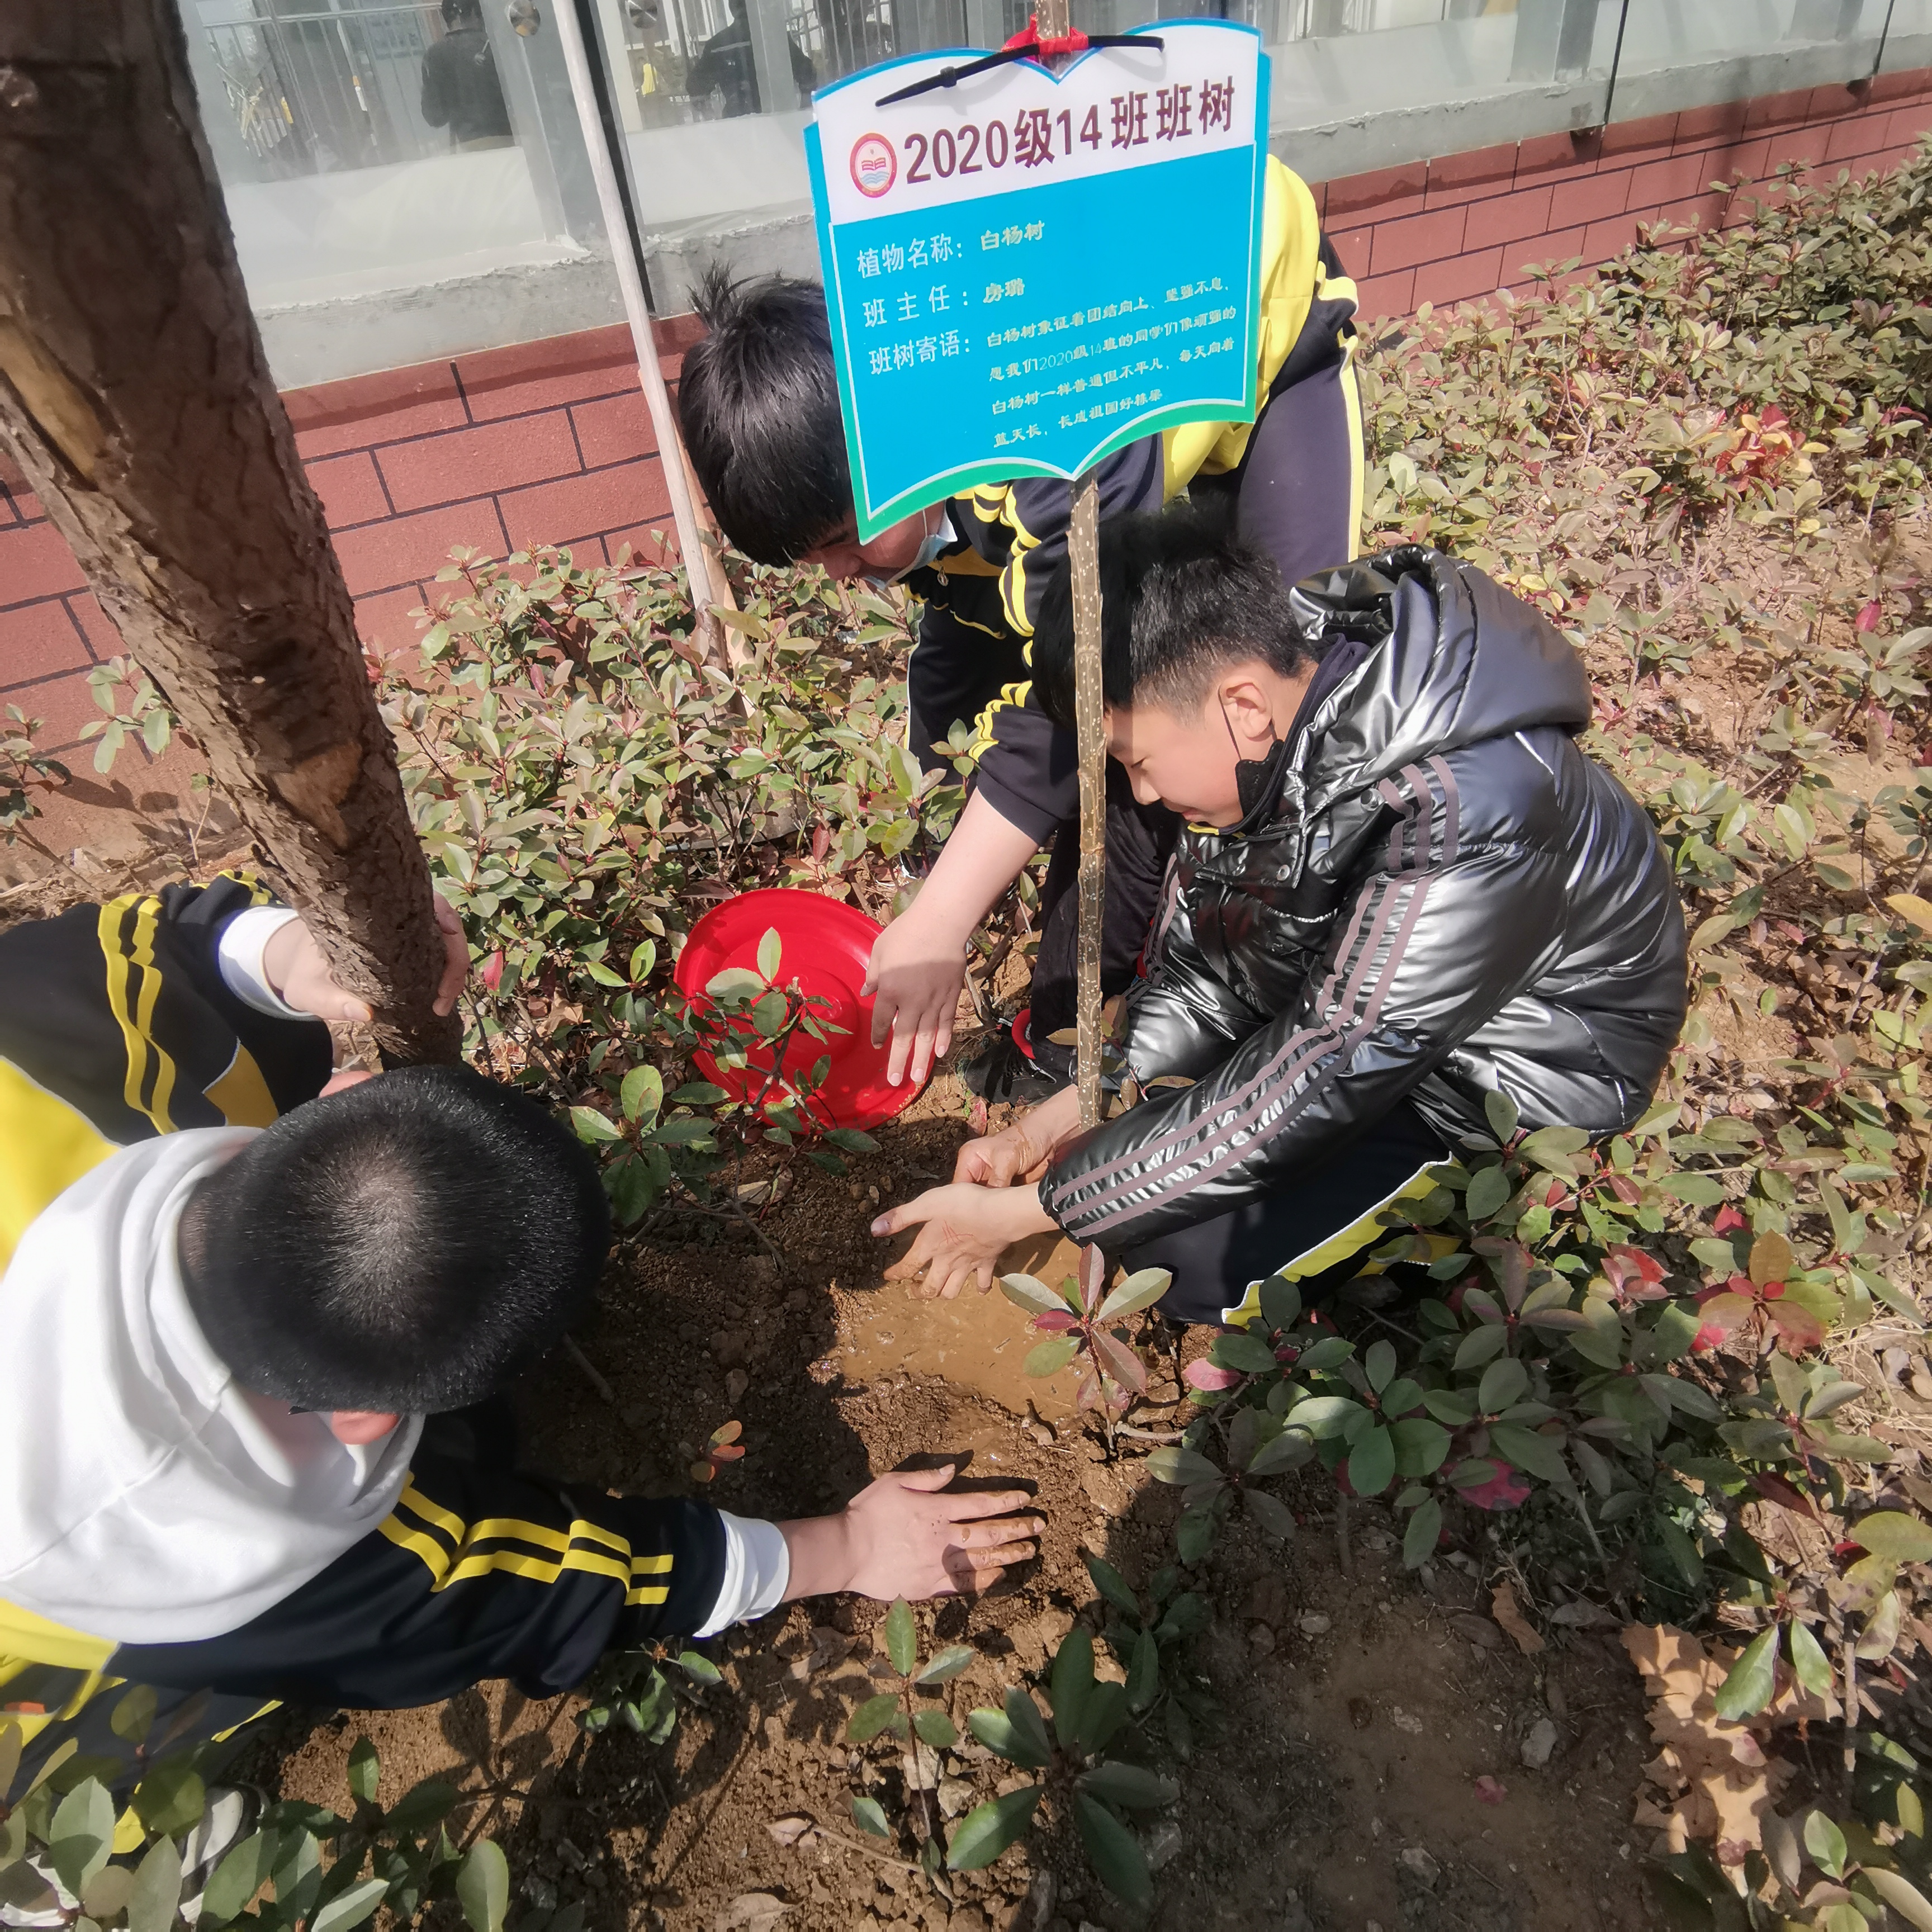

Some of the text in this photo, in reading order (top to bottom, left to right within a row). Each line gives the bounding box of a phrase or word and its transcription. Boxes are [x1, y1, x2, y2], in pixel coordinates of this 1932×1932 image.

[905, 77, 1234, 184] 2020级14班班树
[857, 220, 1044, 278] 植物名称： 白杨树
[863, 285, 967, 327] 班主任：
[869, 330, 969, 375] 班树寄语：
